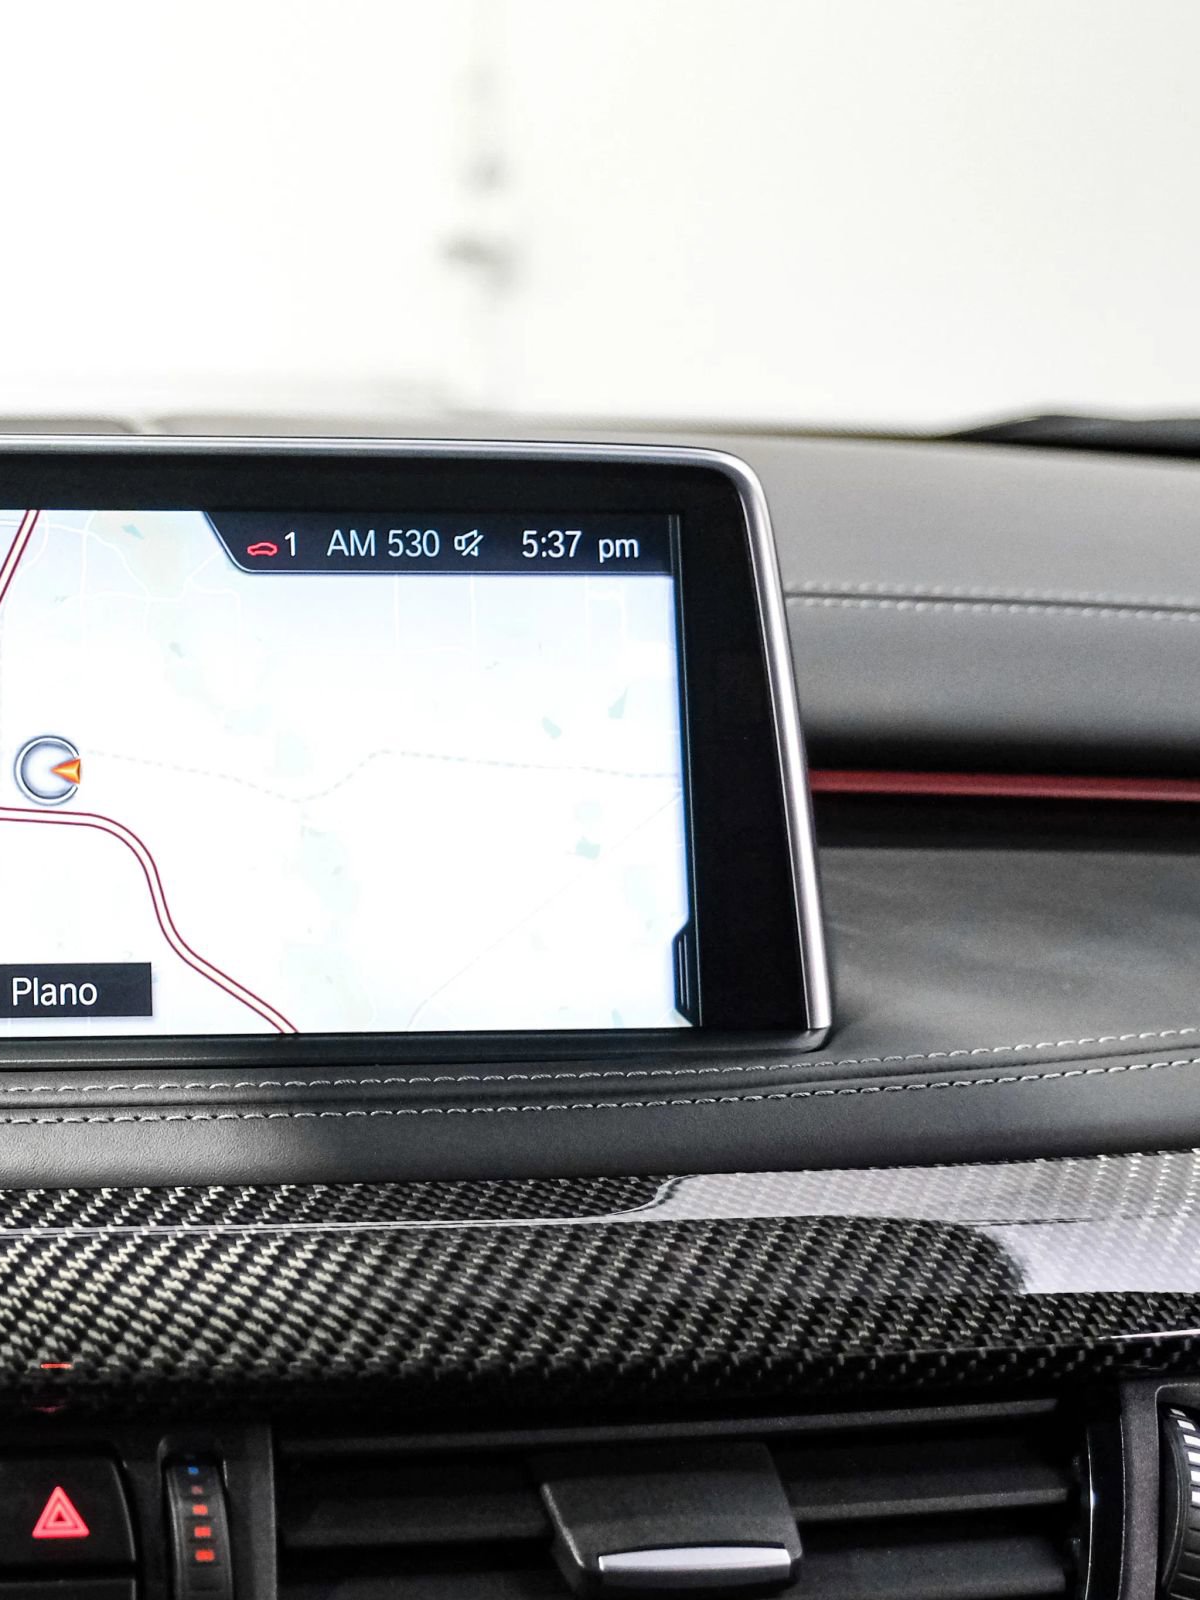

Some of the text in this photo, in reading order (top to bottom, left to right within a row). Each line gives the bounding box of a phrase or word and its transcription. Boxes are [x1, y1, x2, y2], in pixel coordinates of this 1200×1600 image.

[283, 530, 297, 558] 1
[325, 529, 441, 559] AM 530
[521, 529, 640, 564] 5:37 pm
[11, 976, 98, 1007] Plano
